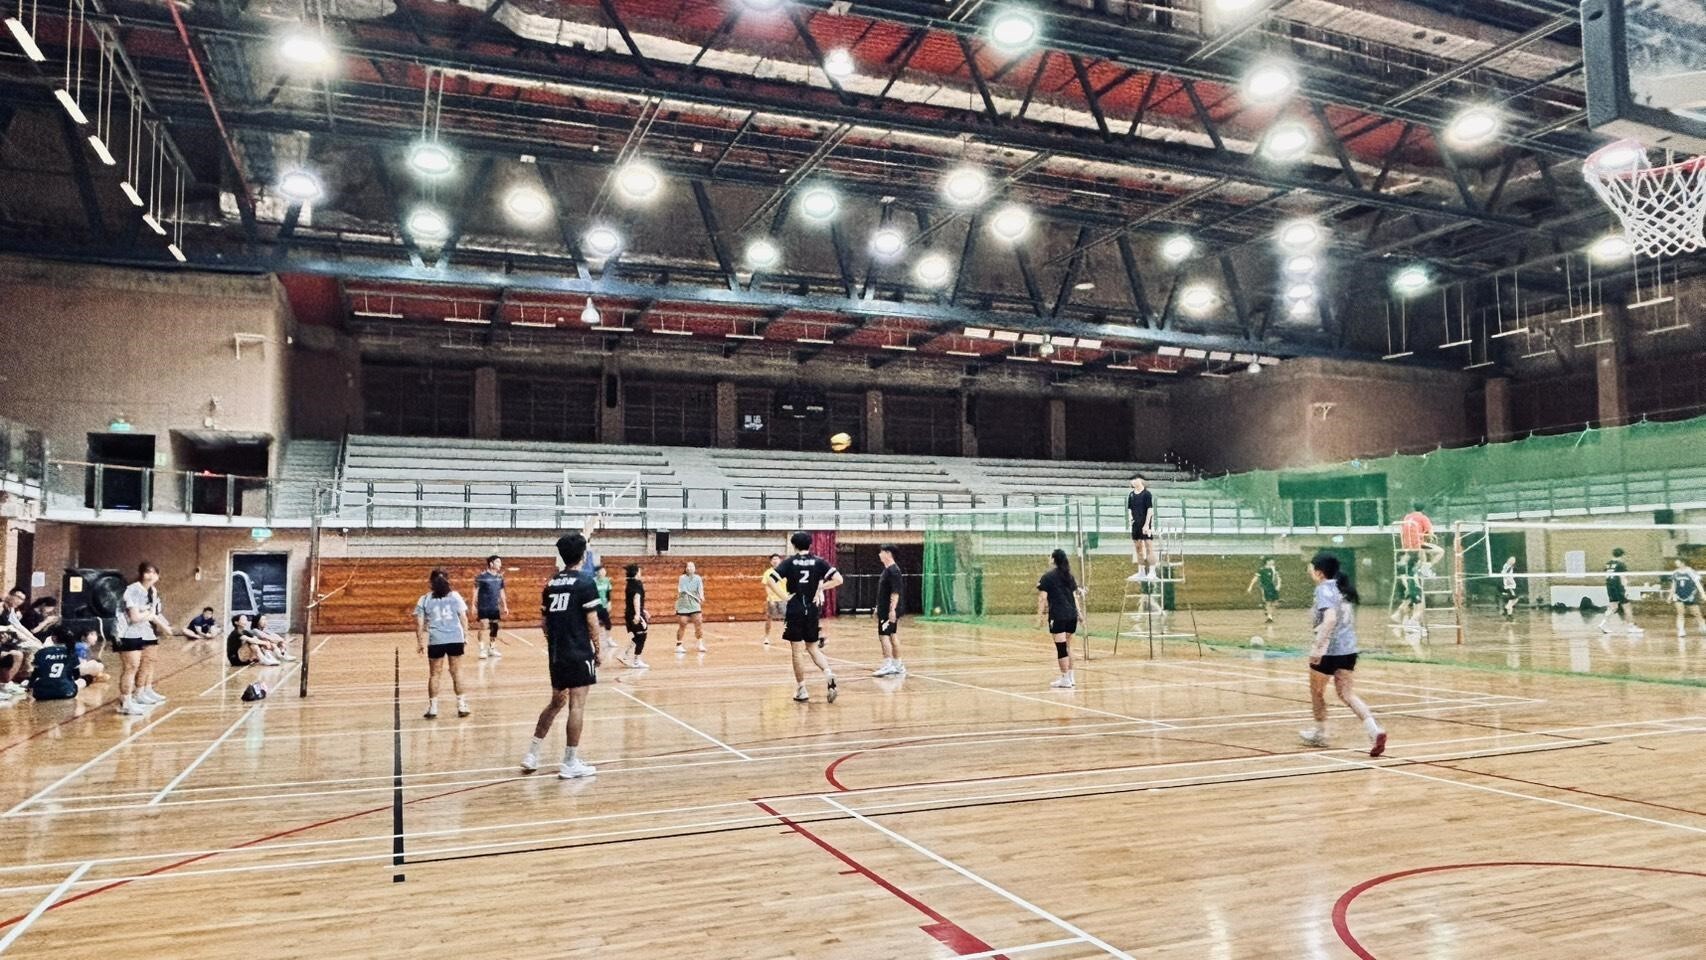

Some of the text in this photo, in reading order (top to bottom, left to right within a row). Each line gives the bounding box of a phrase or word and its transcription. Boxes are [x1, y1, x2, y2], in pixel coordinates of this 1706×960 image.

[799, 570, 809, 583] 2
[549, 592, 571, 612] 20
[49, 663, 65, 678] 9
